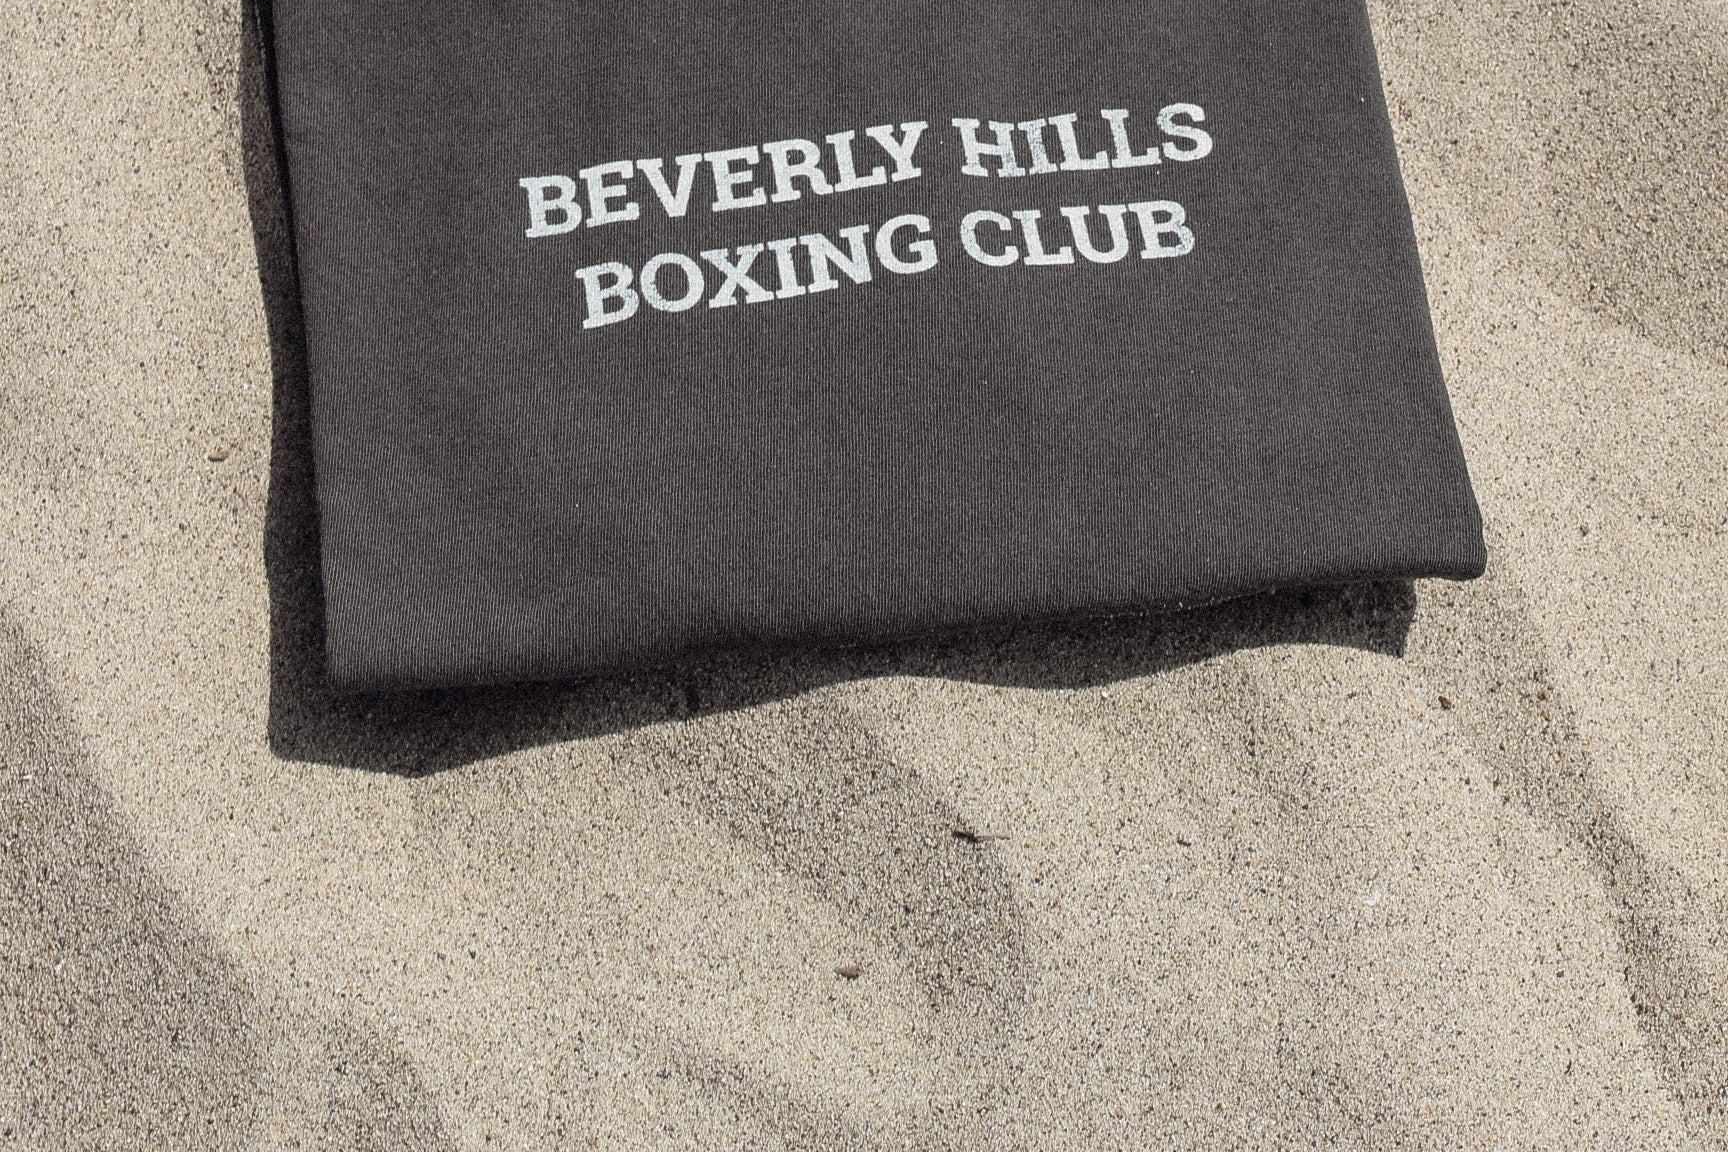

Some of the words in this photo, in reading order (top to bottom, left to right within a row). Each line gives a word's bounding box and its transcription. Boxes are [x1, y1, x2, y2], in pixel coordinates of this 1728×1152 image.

[519, 121, 928, 238] BEVERLY
[952, 103, 1213, 178] HILLS
[575, 214, 938, 329] BOXING
[960, 200, 1195, 267] CLUB
